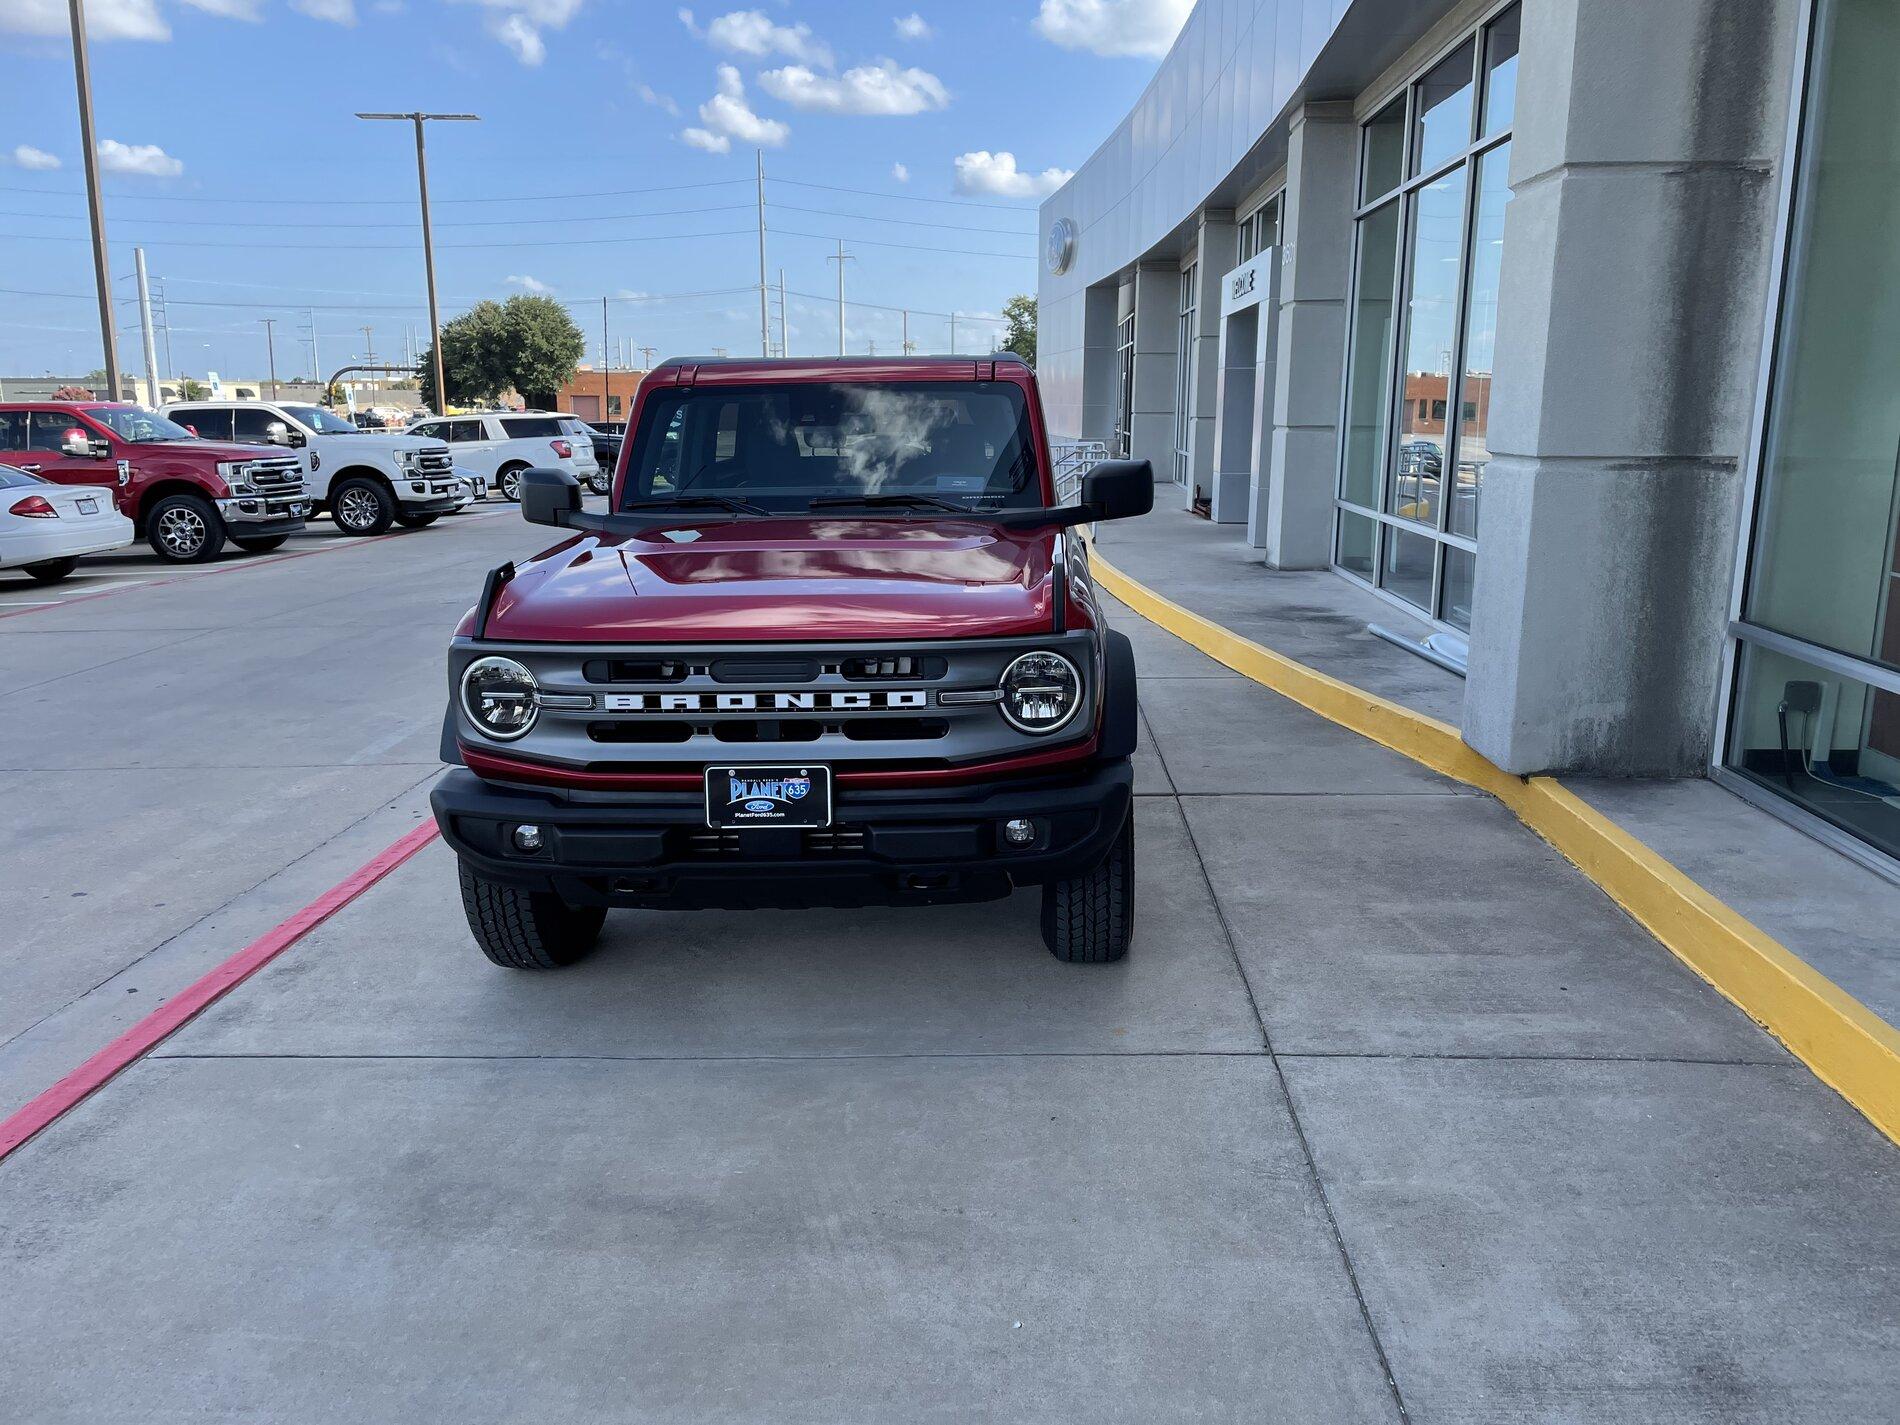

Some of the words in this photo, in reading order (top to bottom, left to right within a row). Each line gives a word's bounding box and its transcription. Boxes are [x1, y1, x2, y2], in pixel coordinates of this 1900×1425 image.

[604, 692, 927, 709] BRONCO
[731, 778, 787, 802] PLANET
[788, 785, 806, 795] 635
